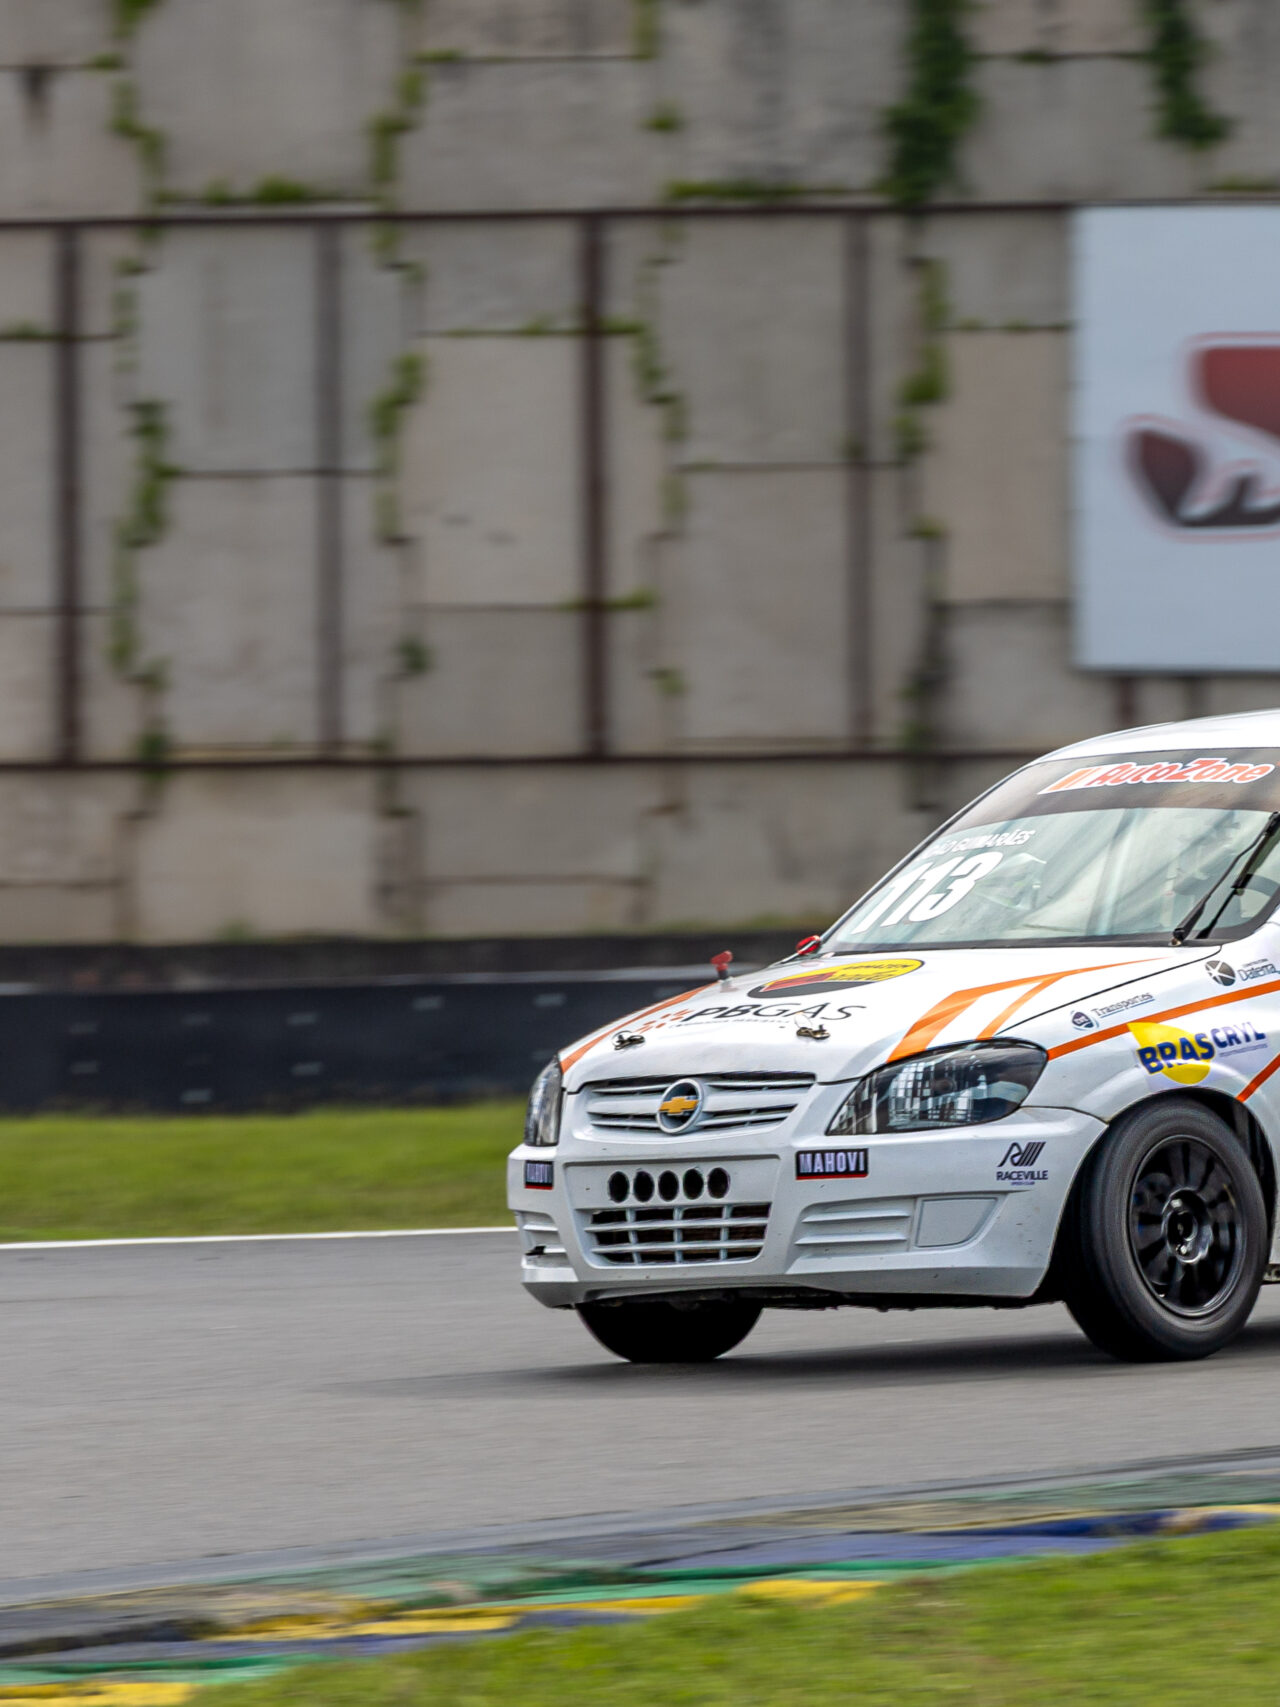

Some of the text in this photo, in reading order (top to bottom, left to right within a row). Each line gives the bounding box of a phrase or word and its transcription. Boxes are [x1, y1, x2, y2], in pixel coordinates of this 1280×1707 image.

[1085, 758, 1274, 787] AutoZone
[850, 851, 1004, 935] 113
[1136, 1021, 1267, 1075] BRASCRYL
[799, 1151, 866, 1173] MAHOVI
[996, 1170, 1049, 1181] RACEVILLE
